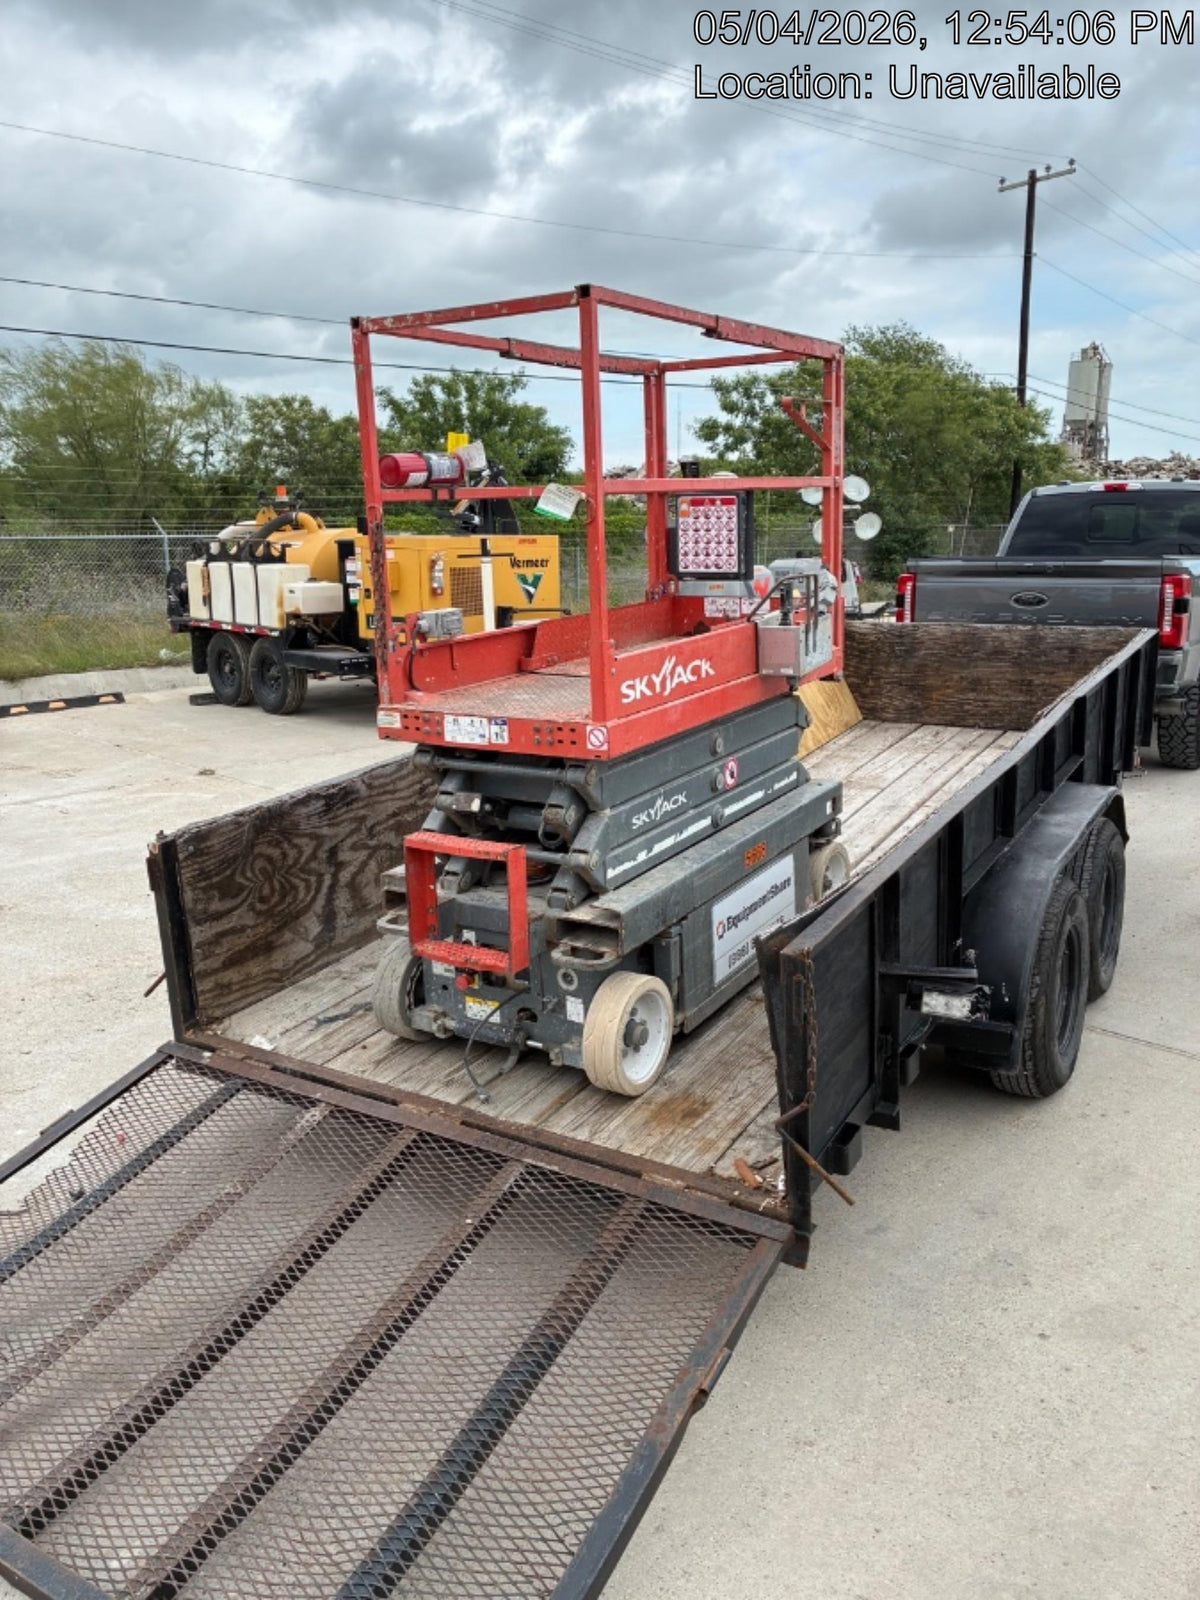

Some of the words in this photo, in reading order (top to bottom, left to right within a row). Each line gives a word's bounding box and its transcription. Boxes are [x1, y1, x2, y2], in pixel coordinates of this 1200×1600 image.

[509, 557, 550, 569] Vermeer
[620, 655, 716, 704] SKYJACK
[631, 790, 688, 829] SKYJACK
